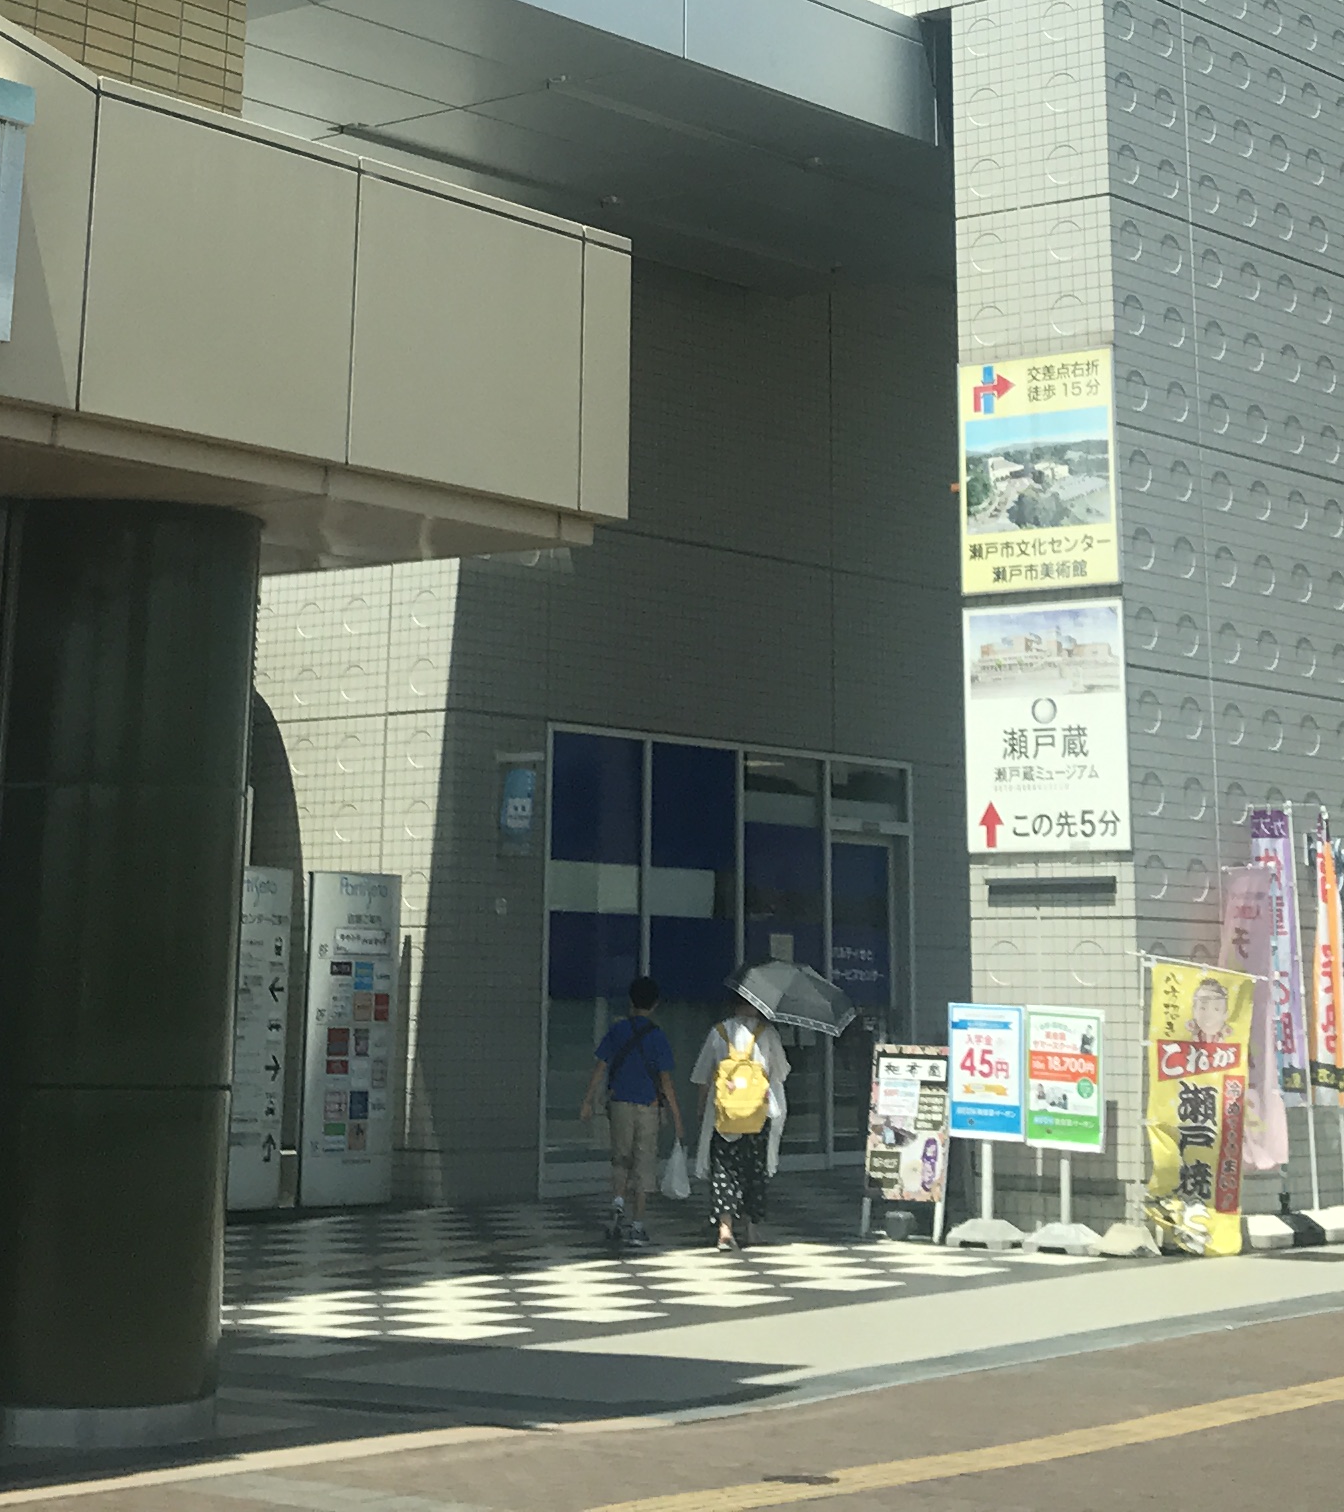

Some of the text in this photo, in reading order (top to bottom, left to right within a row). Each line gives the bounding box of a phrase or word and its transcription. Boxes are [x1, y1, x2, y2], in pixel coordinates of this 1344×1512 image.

[1027, 359, 1099, 383] 交差点右折
[968, 533, 1111, 561] 瀬戸市文化センター
[992, 560, 1088, 584] 瀬戸市美術館
[1002, 724, 1089, 760] 瀬戸蔵
[994, 764, 1100, 782] 瀬戸蔵ミュージアム
[1013, 809, 1121, 838] この先5分
